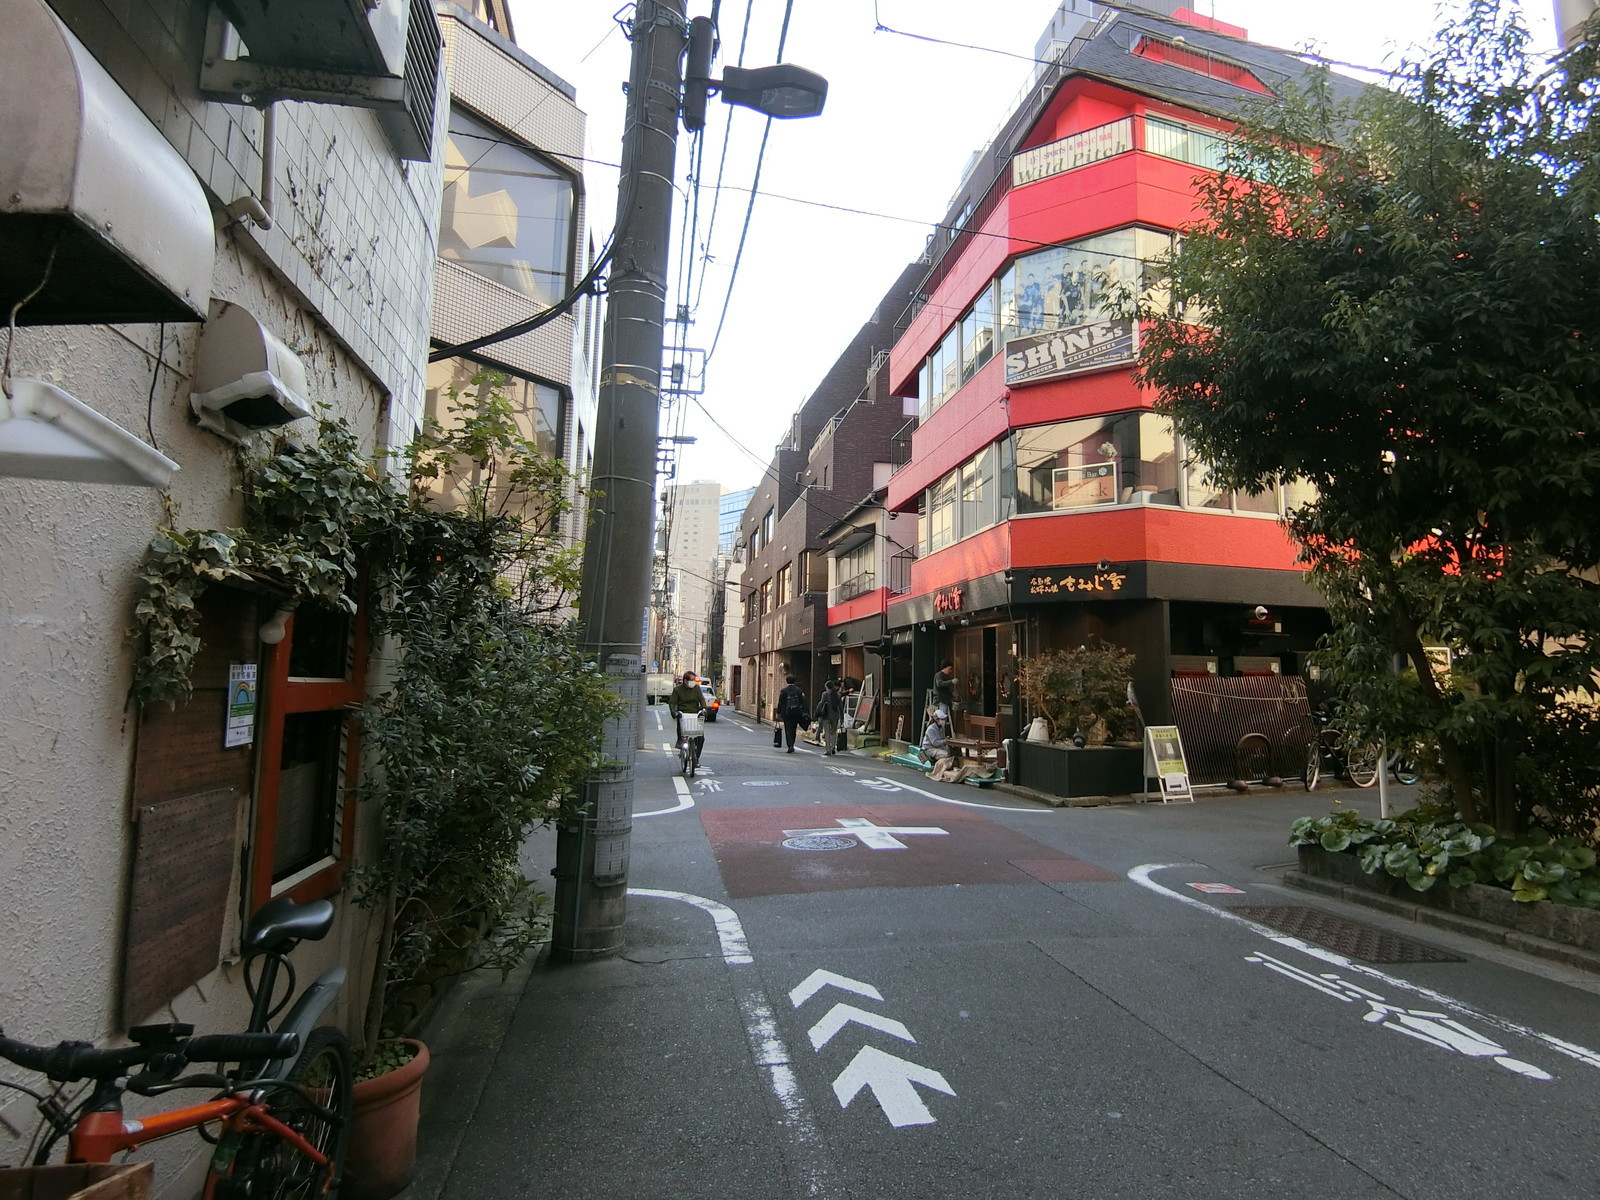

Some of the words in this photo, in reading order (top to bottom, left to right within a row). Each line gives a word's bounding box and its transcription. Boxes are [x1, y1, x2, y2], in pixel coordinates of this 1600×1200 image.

[1019, 157, 1064, 183] Wild
[1072, 141, 1126, 167] Pitch
[1068, 351, 1087, 362] CAFE
[1089, 342, 1116, 355] SHINES
[1029, 364, 1053, 376] SOCCER
[1060, 572, 1126, 592] もみじ屋
